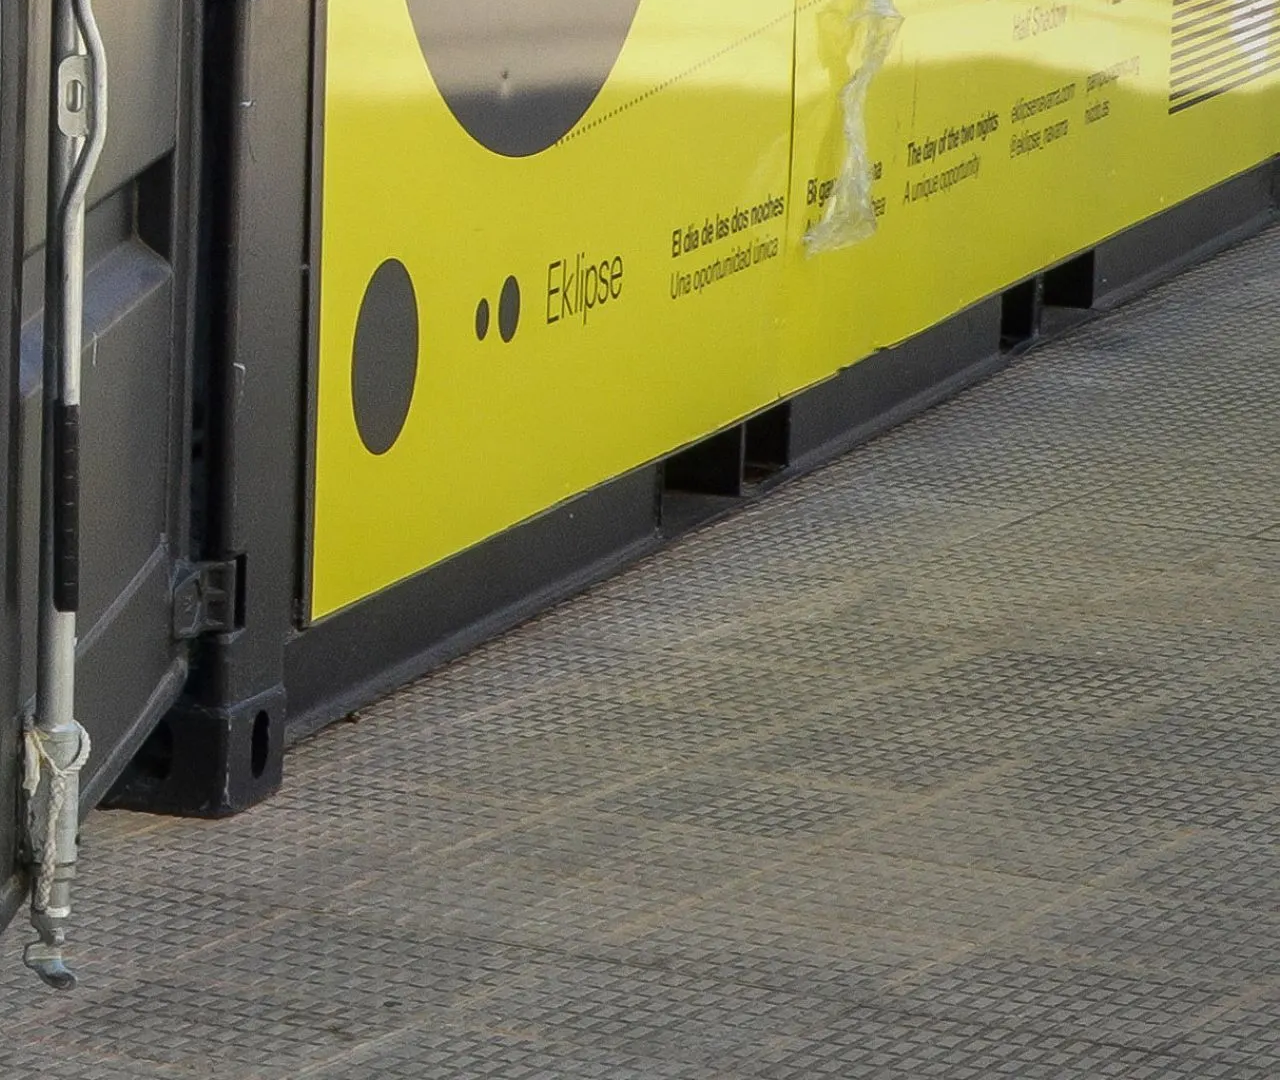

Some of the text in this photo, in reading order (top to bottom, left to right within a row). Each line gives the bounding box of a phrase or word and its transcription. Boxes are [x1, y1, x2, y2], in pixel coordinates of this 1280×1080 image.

[907, 140, 922, 168] The
[923, 135, 938, 164] day
[671, 228, 682, 258] El
[701, 217, 714, 246] de
[715, 213, 730, 240] las
[731, 206, 749, 233] dos
[750, 193, 784, 226] noches
[546, 252, 624, 325] Eklipse
[670, 270, 692, 300] Una
[692, 239, 752, 295] oportunidad
